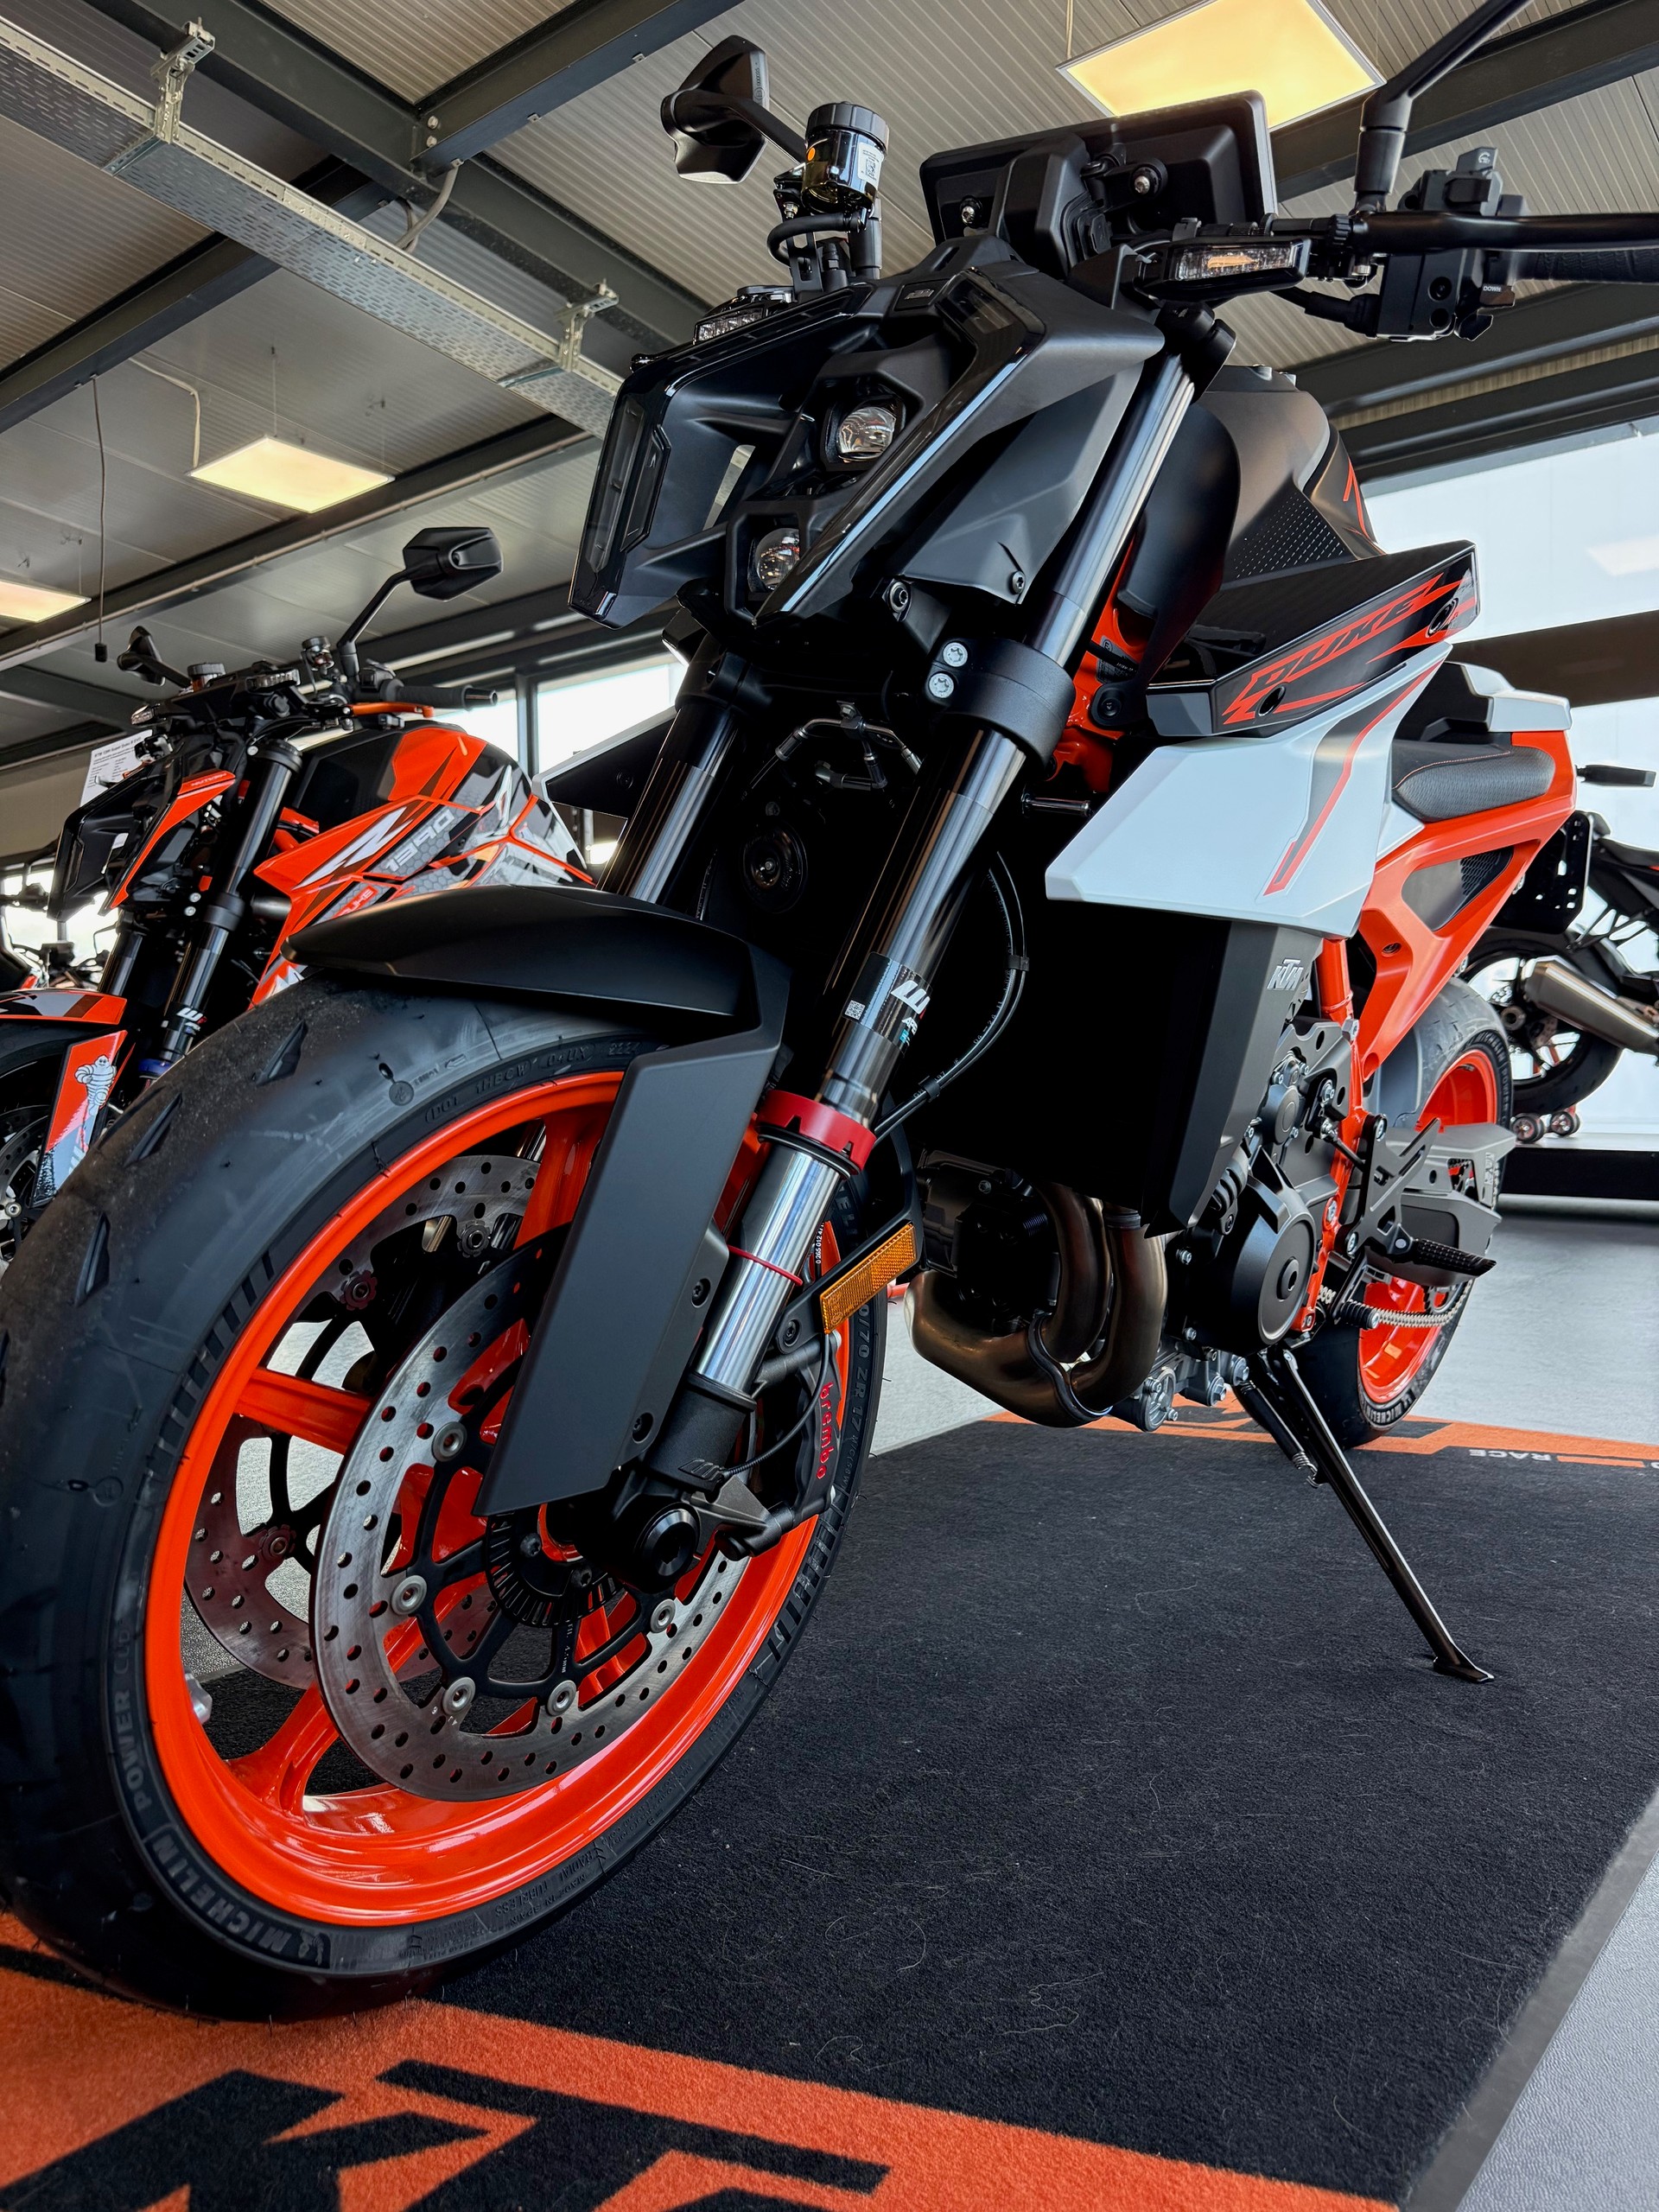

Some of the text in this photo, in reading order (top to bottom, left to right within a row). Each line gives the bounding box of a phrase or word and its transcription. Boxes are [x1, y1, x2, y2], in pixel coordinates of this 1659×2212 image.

[1250, 581, 1434, 689] DUKE
[387, 809, 455, 872] 1390
[1267, 958, 1304, 991] KTM
[901, 1017, 918, 1035] APE
[856, 1367, 868, 1399] ZR
[851, 1406, 862, 1433] 17
[1365, 1402, 1402, 1424] MICHELIN
[817, 1382, 835, 1479] brembo
[1469, 1449, 1552, 1461] RACE
[114, 1690, 152, 1812] POWER
[152, 1834, 292, 1955] MICHELIN
[495, 1850, 596, 1917] RADIAL TUBELESS
[560, 1874, 588, 1896] MADE
[511, 1903, 542, 1926] SPAIN
